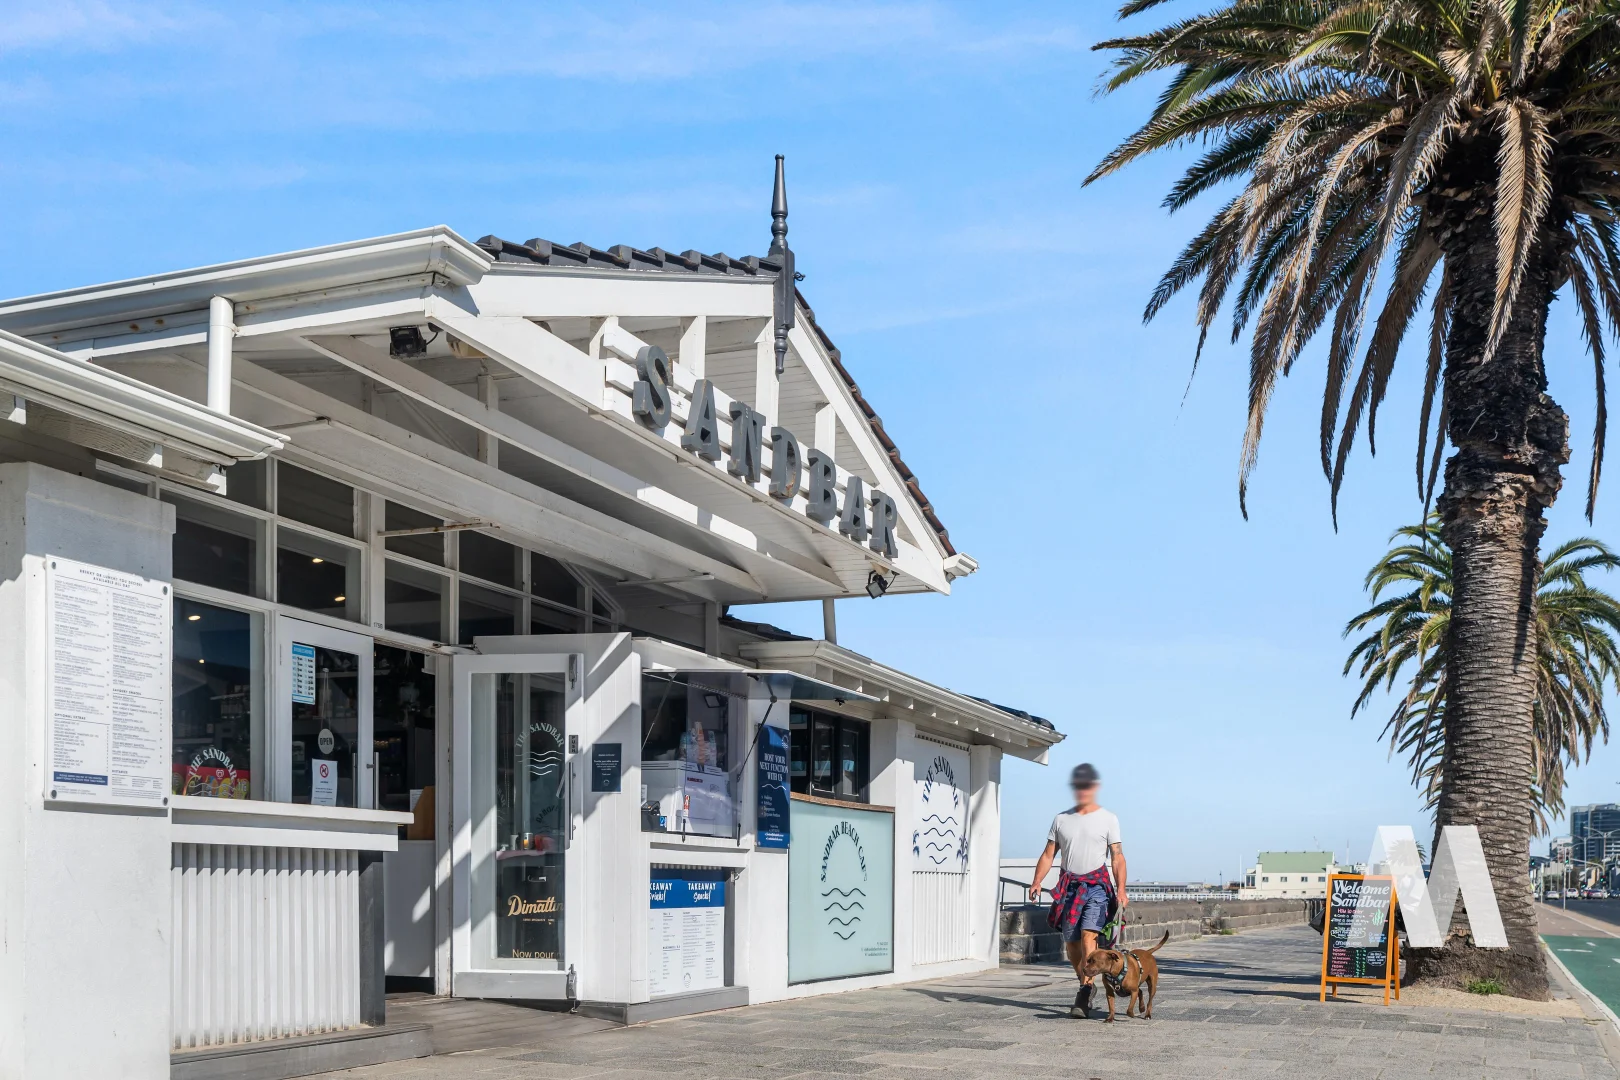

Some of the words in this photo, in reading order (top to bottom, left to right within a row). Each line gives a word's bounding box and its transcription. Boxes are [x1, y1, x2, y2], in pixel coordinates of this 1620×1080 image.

[632, 345, 898, 558] SANDBAR
[320, 737, 333, 746] OPEN
[515, 731, 529, 748] THE
[529, 722, 564, 748] SANDBAR
[188, 754, 204, 777] THE
[202, 748, 237, 781] SANDBAR
[759, 761, 770, 770] NEXT
[770, 763, 789, 774] FUNCTION
[775, 755, 786, 765] YOUR
[778, 773, 783, 782] US
[921, 765, 935, 804] THE
[933, 756, 959, 809] SANDBAR
[820, 824, 841, 883] SANDBAR
[841, 821, 860, 847] BEACH
[688, 882, 717, 891] TAKEAWAY
[1333, 880, 1390, 895] Welcome
[1331, 893, 1389, 908] Sandbar
[512, 949, 532, 959] Now
